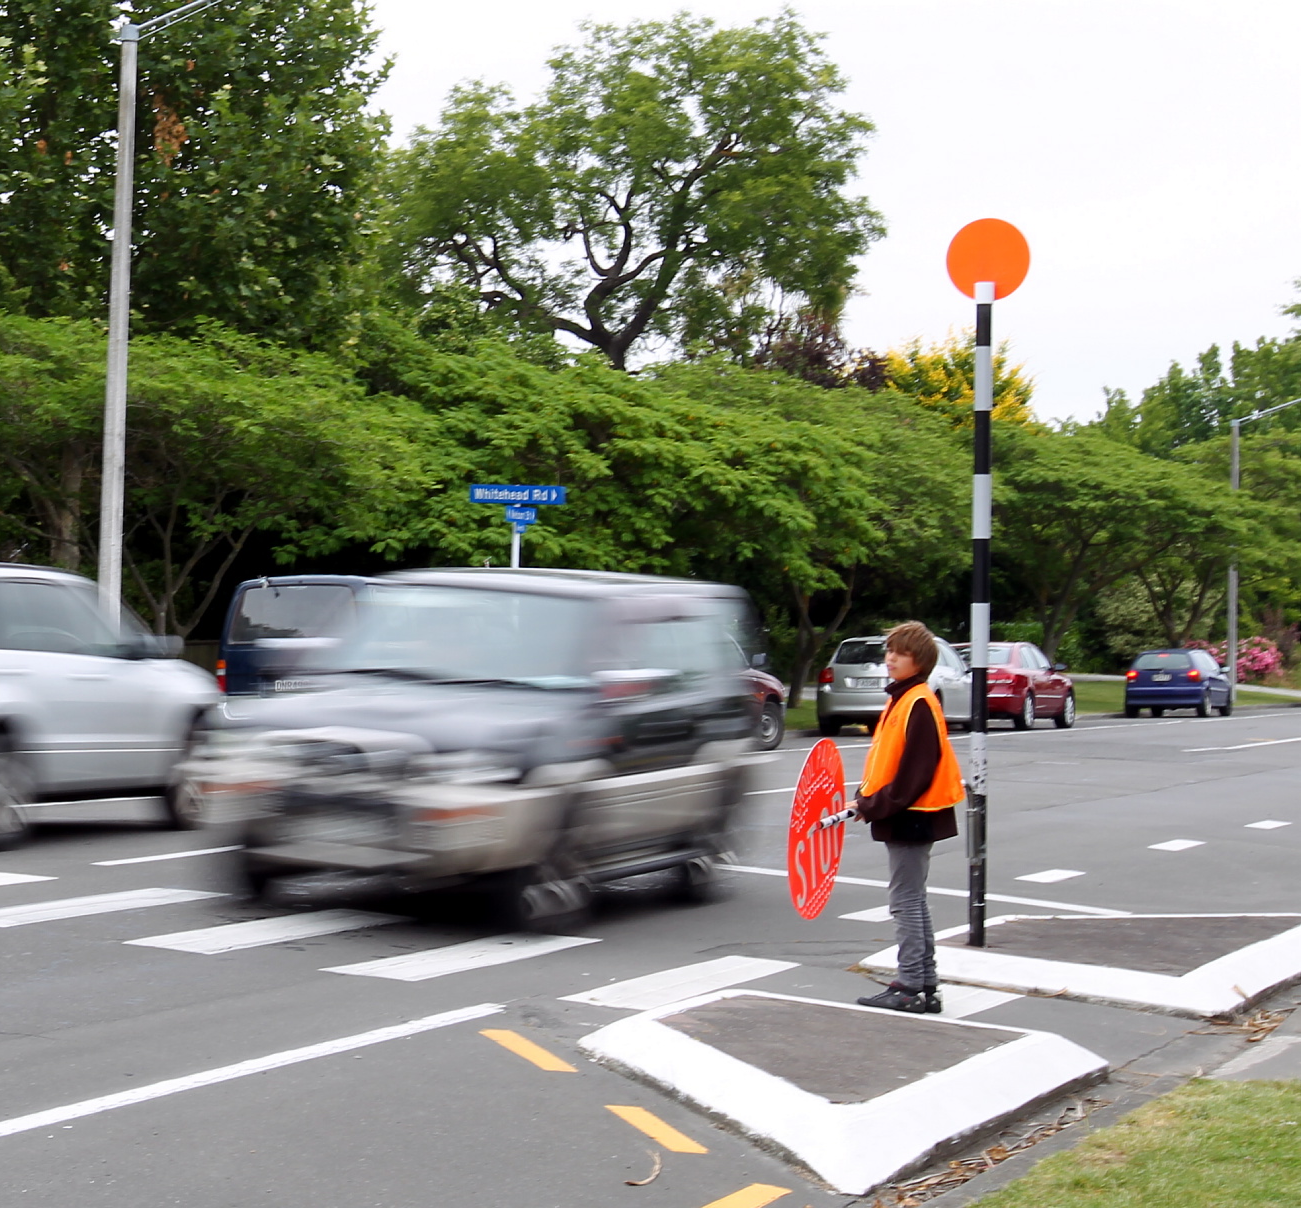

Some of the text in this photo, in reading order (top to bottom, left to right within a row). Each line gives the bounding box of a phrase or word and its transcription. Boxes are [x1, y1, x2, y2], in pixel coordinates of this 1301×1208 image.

[473, 488, 549, 501] Whitehead Rd
[794, 790, 843, 909] STOP
